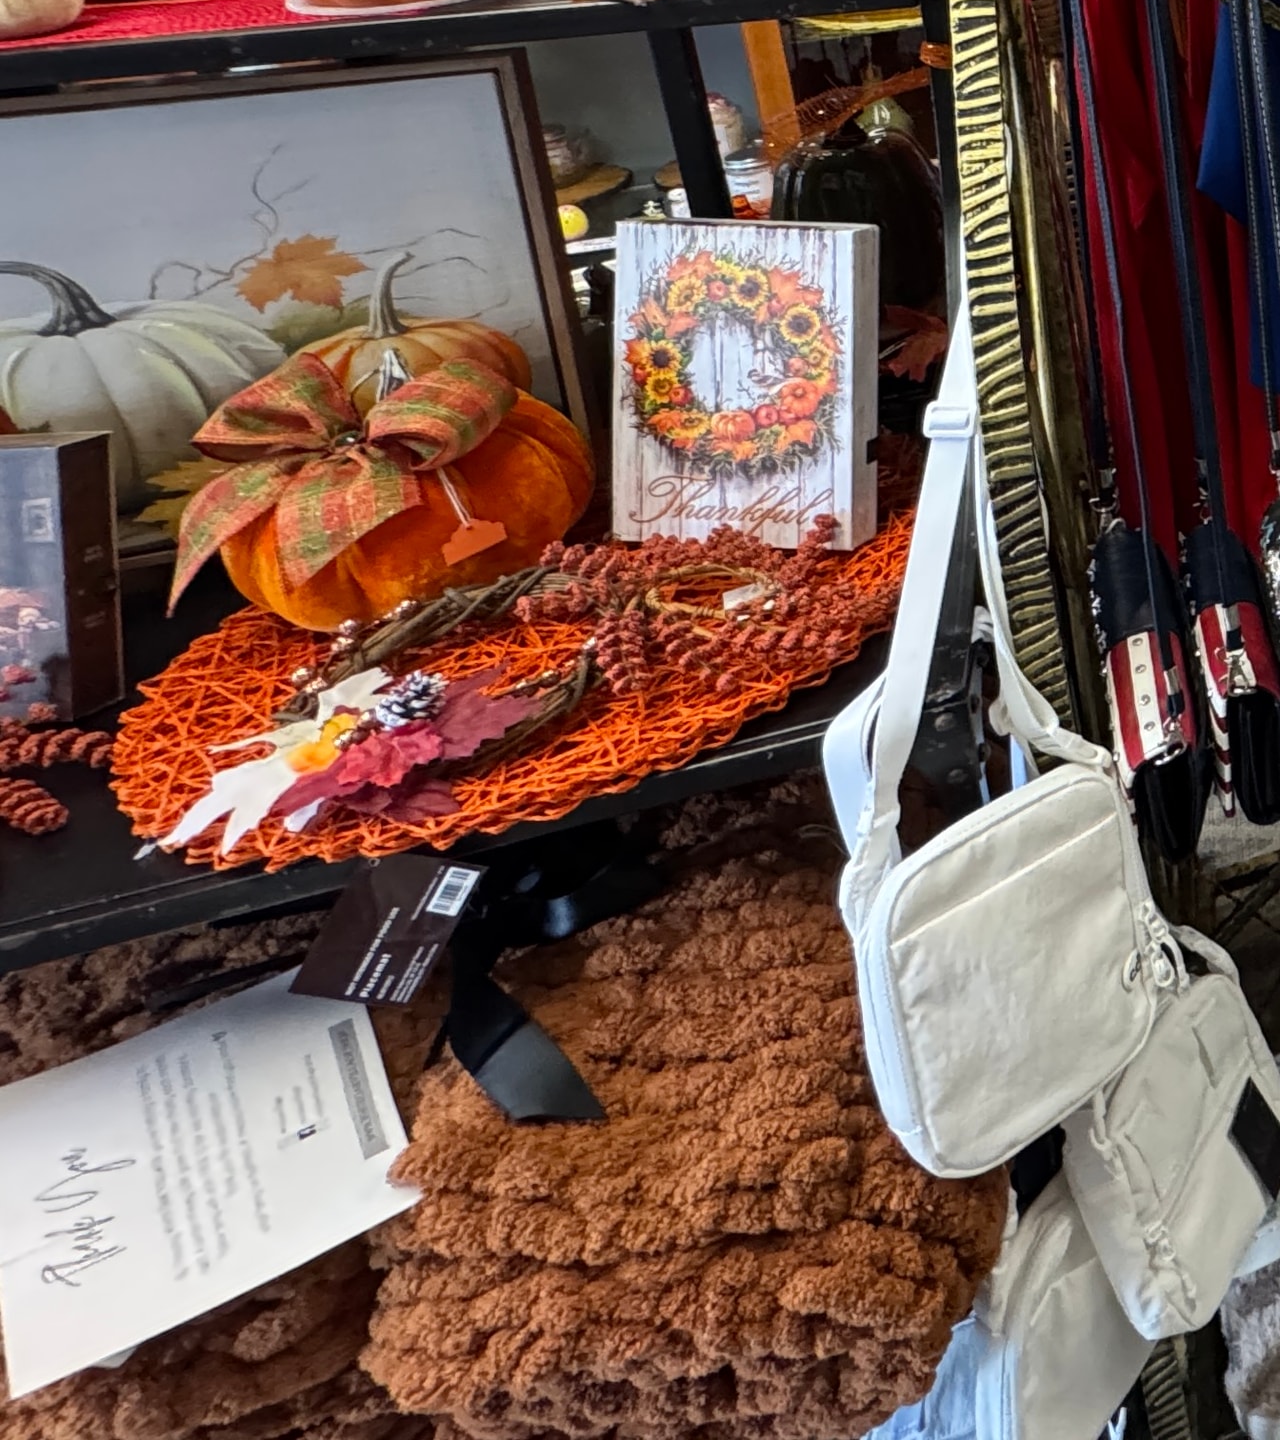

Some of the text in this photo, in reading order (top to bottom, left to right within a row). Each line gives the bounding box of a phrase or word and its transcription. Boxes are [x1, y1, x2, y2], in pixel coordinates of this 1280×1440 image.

[628, 474, 833, 537] Thankful
[358, 953, 393, 998] Placemat
[33, 1147, 137, 1287] Thank You
